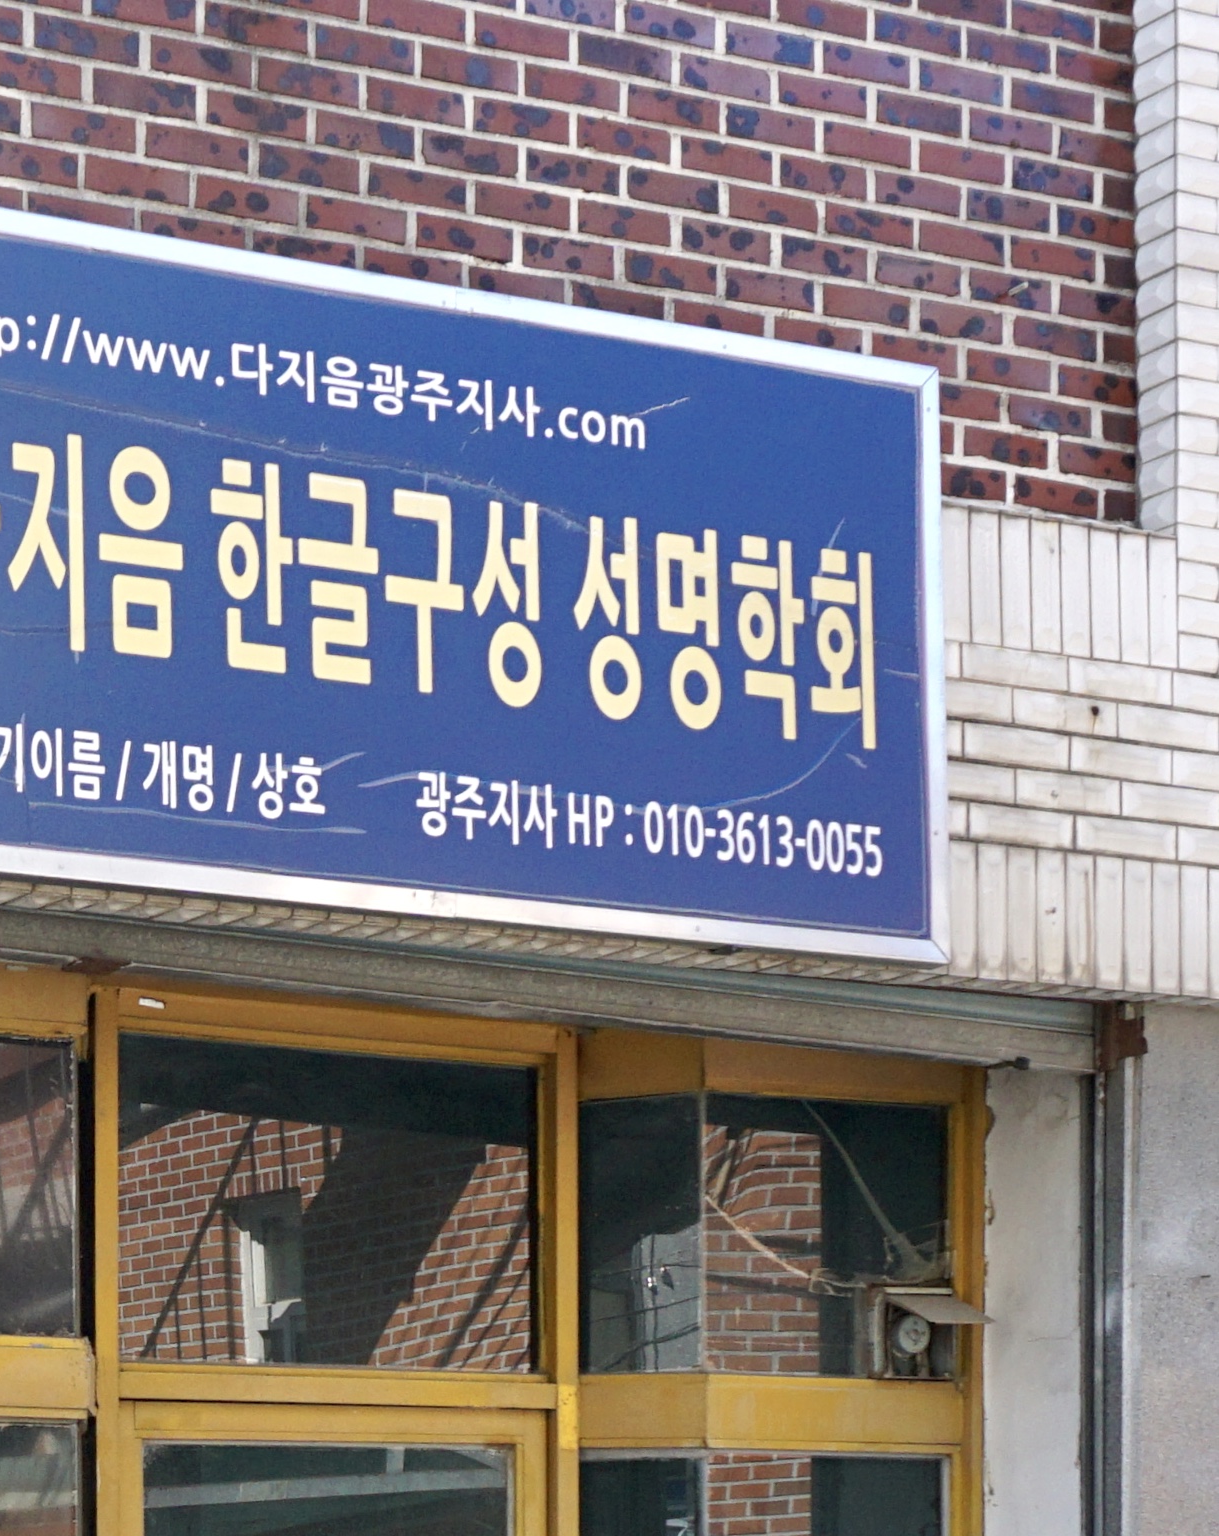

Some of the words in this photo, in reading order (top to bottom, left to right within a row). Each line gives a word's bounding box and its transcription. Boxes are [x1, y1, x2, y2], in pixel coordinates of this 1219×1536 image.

[210, 458, 542, 708] 한글구성
[574, 516, 876, 750] 성명학회
[416, 771, 558, 849] 광주지사
[567, 792, 615, 848] HP
[643, 801, 883, 877] 010-3613-0055
